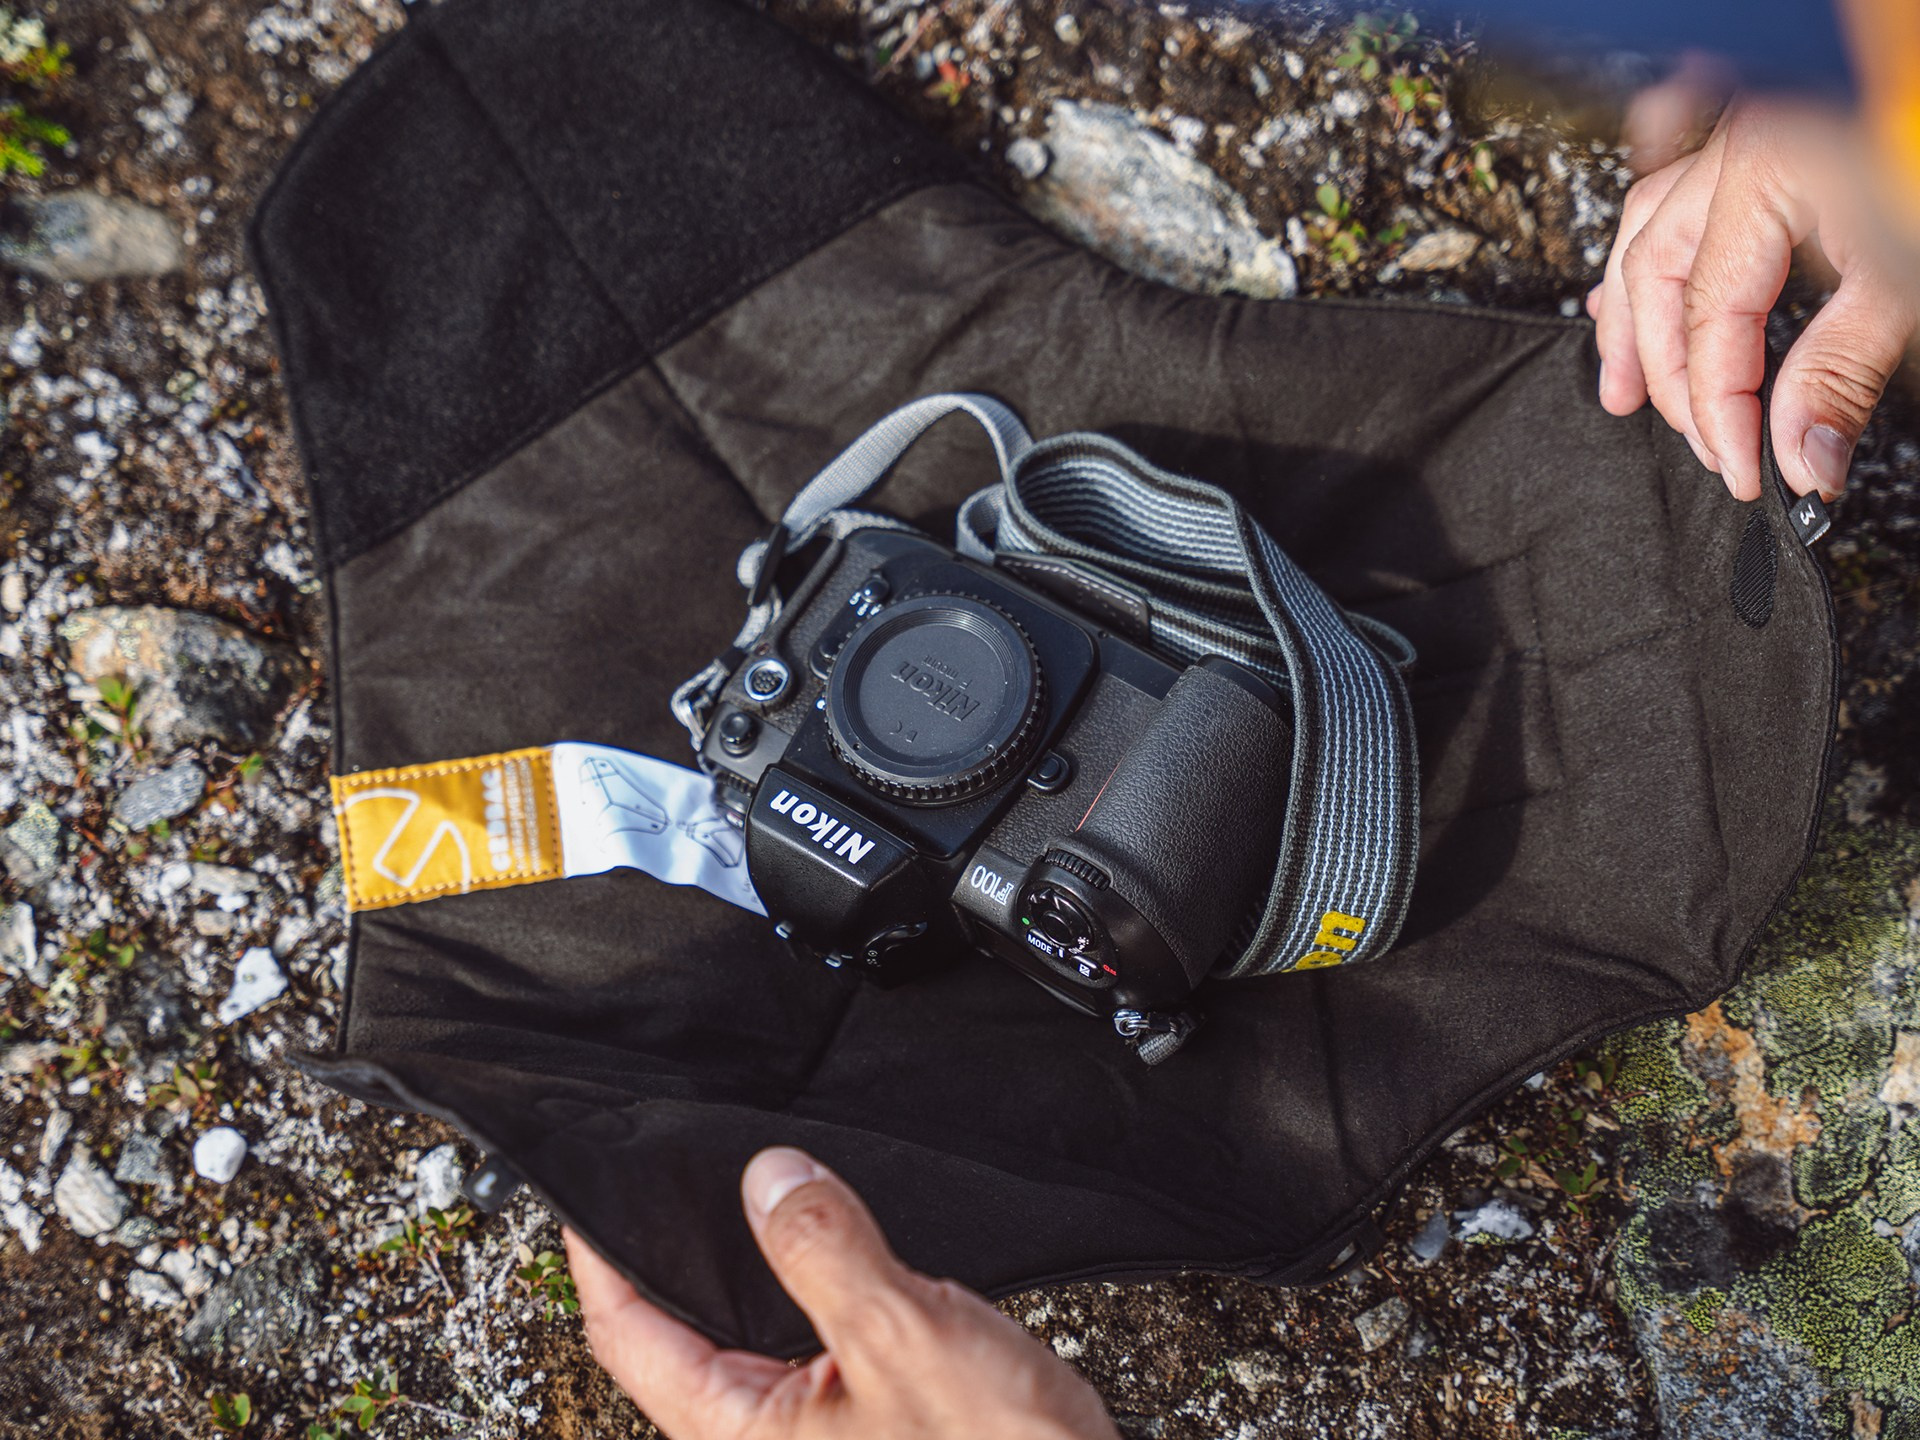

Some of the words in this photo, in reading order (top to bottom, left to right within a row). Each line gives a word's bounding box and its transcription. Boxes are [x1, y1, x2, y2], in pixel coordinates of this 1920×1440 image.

[890, 660, 980, 722] Nikon
[770, 789, 876, 865] Nikon
[970, 865, 1014, 906] F100
[1027, 933, 1053, 956] MODE
